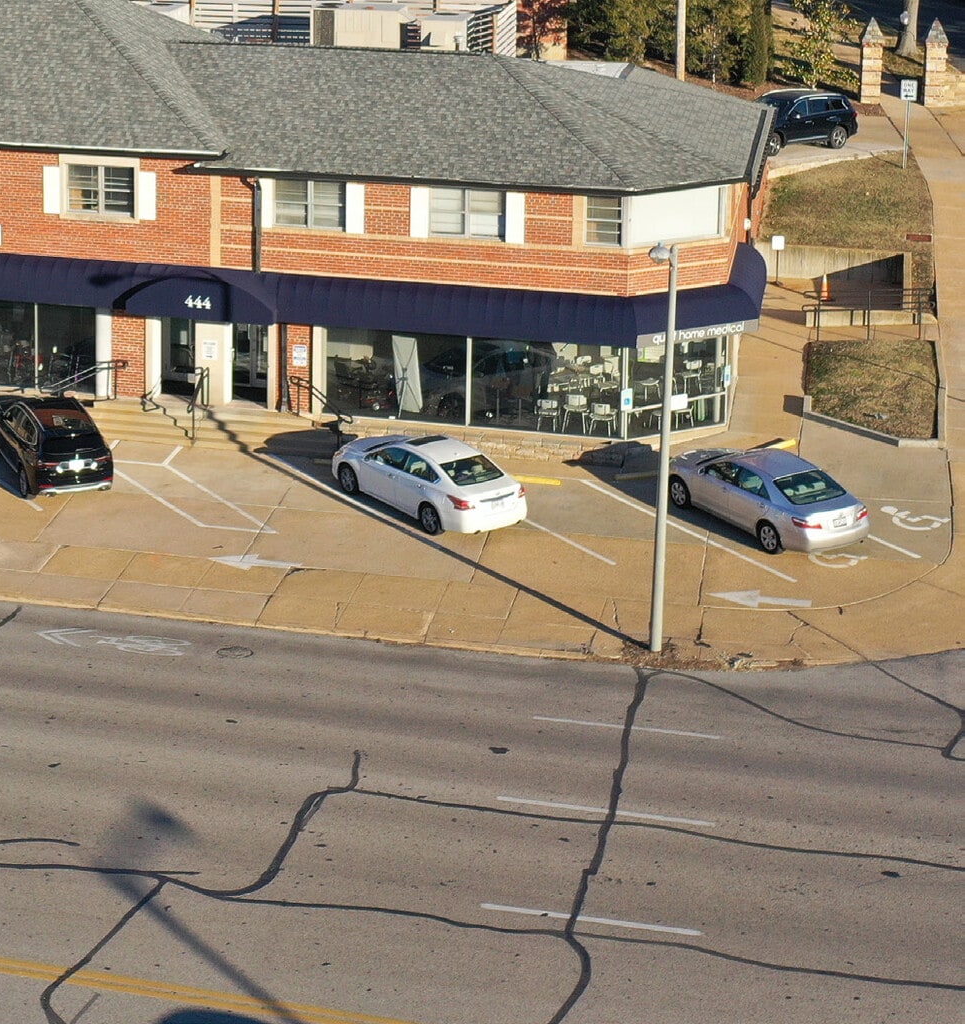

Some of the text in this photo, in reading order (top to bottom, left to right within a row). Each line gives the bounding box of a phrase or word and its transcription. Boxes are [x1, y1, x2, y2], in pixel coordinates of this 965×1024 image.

[184, 295, 212, 310] 444
[679, 329, 705, 340] home
[707, 321, 745, 336] medical
